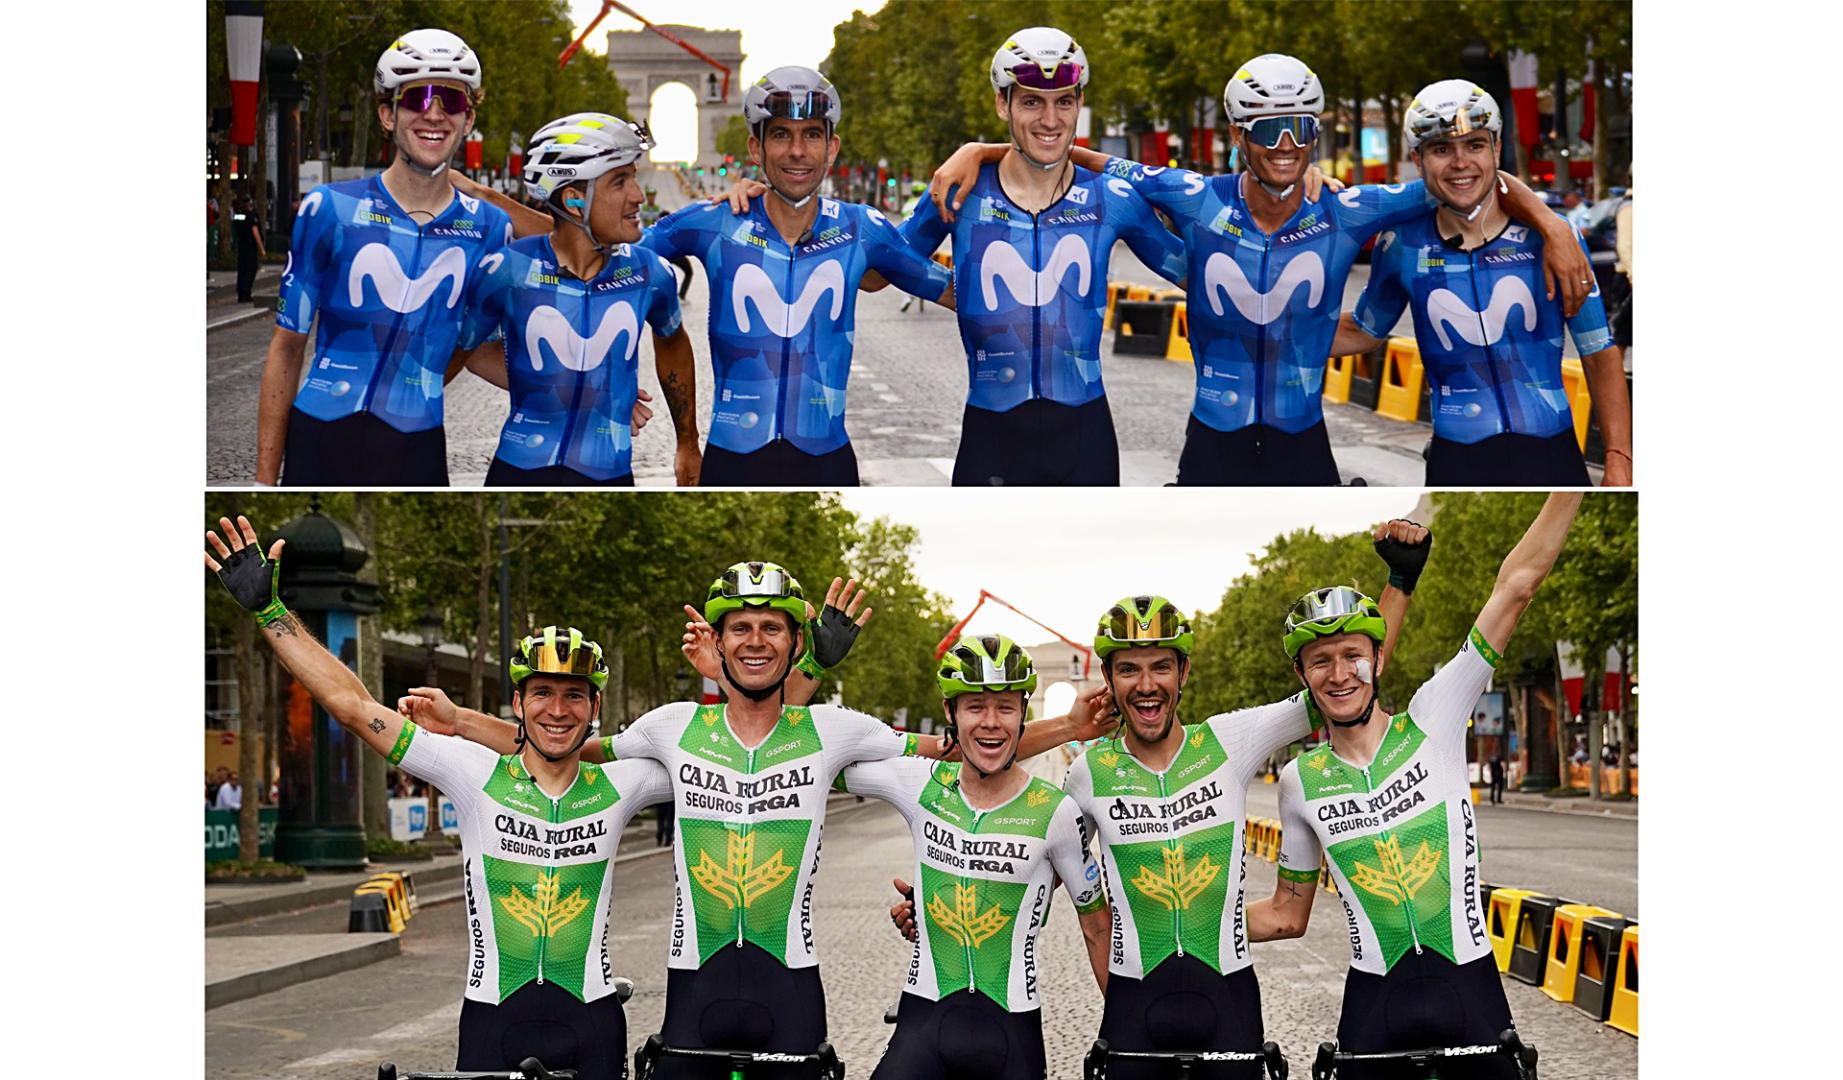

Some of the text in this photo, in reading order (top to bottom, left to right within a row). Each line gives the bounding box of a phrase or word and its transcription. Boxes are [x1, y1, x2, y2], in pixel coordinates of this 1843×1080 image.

[551, 168, 573, 176] ABUS
[433, 227, 483, 239] CANYON
[1048, 212, 1098, 225] CANYON
[1280, 220, 1330, 244] CANYON
[803, 232, 853, 254] CANYON
[1485, 252, 1536, 264] CANYON
[597, 274, 645, 292] CANYON
[765, 739, 802, 758] GSPORT
[1382, 734, 1413, 767] GSPORT
[680, 764, 815, 798] CAJA RURAL
[1178, 754, 1213, 778] GSPORT
[572, 793, 603, 810] GSPORT
[685, 791, 801, 815] SEGUROS RGA
[1109, 780, 1223, 821] CAJA RURAL
[1317, 762, 1429, 822] CAJA RURAL
[994, 818, 1037, 826] GSPORT
[1119, 805, 1217, 836] SEGUROS RGA
[1328, 790, 1426, 836] SEGUROS RGA
[494, 814, 607, 846] CAJA RURAL
[924, 821, 1030, 861] CAJA RURAL
[500, 838, 597, 860] SEGUROS RGA
[926, 844, 1015, 874] SEGUROS RGA
[1462, 799, 1486, 947] CAJA RURAL
[671, 886, 684, 958] SEGUROS
[800, 881, 814, 955] RURAL
[1233, 889, 1247, 960] RURAL
[1343, 900, 1364, 961] SEGUROS
[1023, 884, 1046, 1001] CAJA RURAL
[1113, 905, 1124, 966] SEGUROS
[469, 918, 485, 989] SEGUROS
[751, 1052, 806, 1063] Vision
[1203, 1051, 1257, 1061] Vision
[1445, 1044, 1498, 1057] Vision
